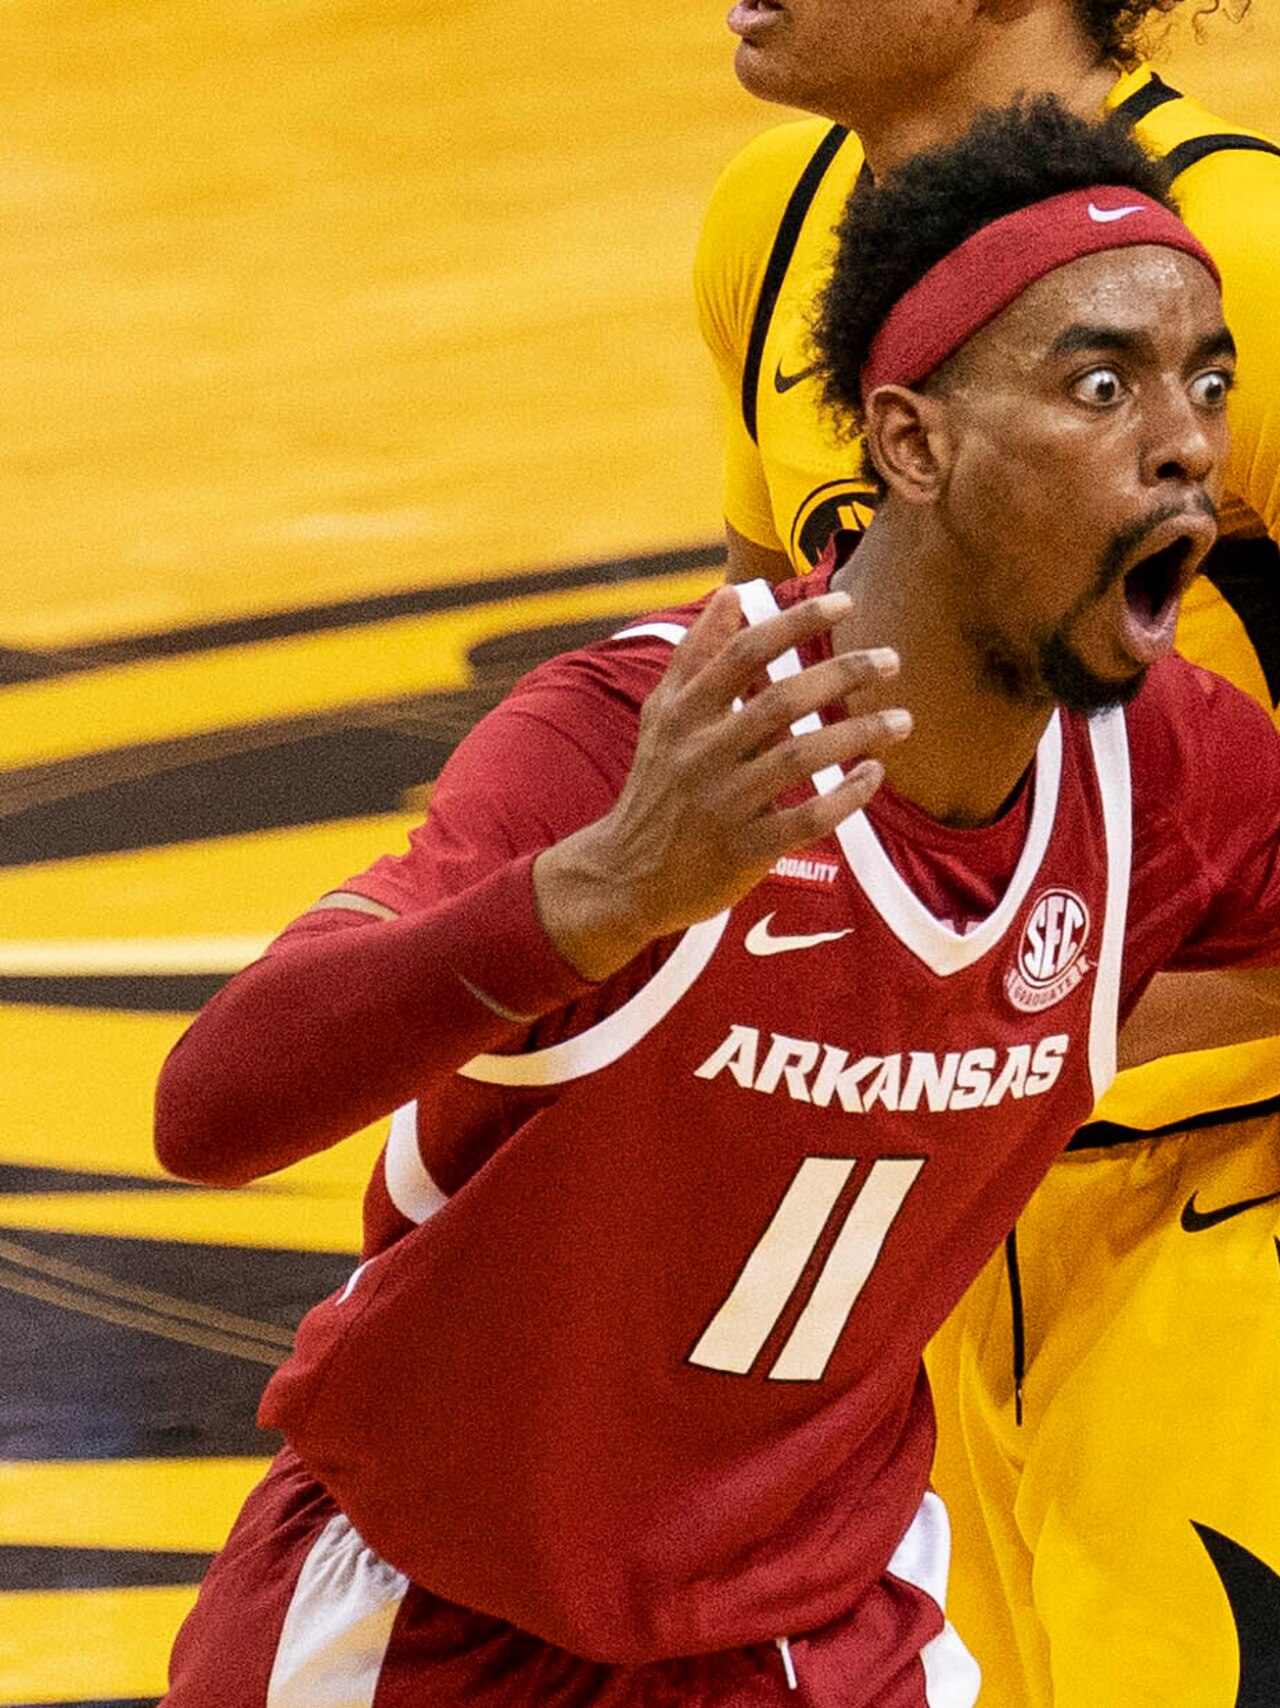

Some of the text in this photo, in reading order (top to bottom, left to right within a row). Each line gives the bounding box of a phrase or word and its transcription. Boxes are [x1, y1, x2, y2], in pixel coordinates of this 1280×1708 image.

[768, 857, 839, 883] QUALITY
[1024, 895, 1084, 979] SEC
[693, 1024, 1070, 1113] ARKANSAS
[685, 1156, 927, 1382] 11
